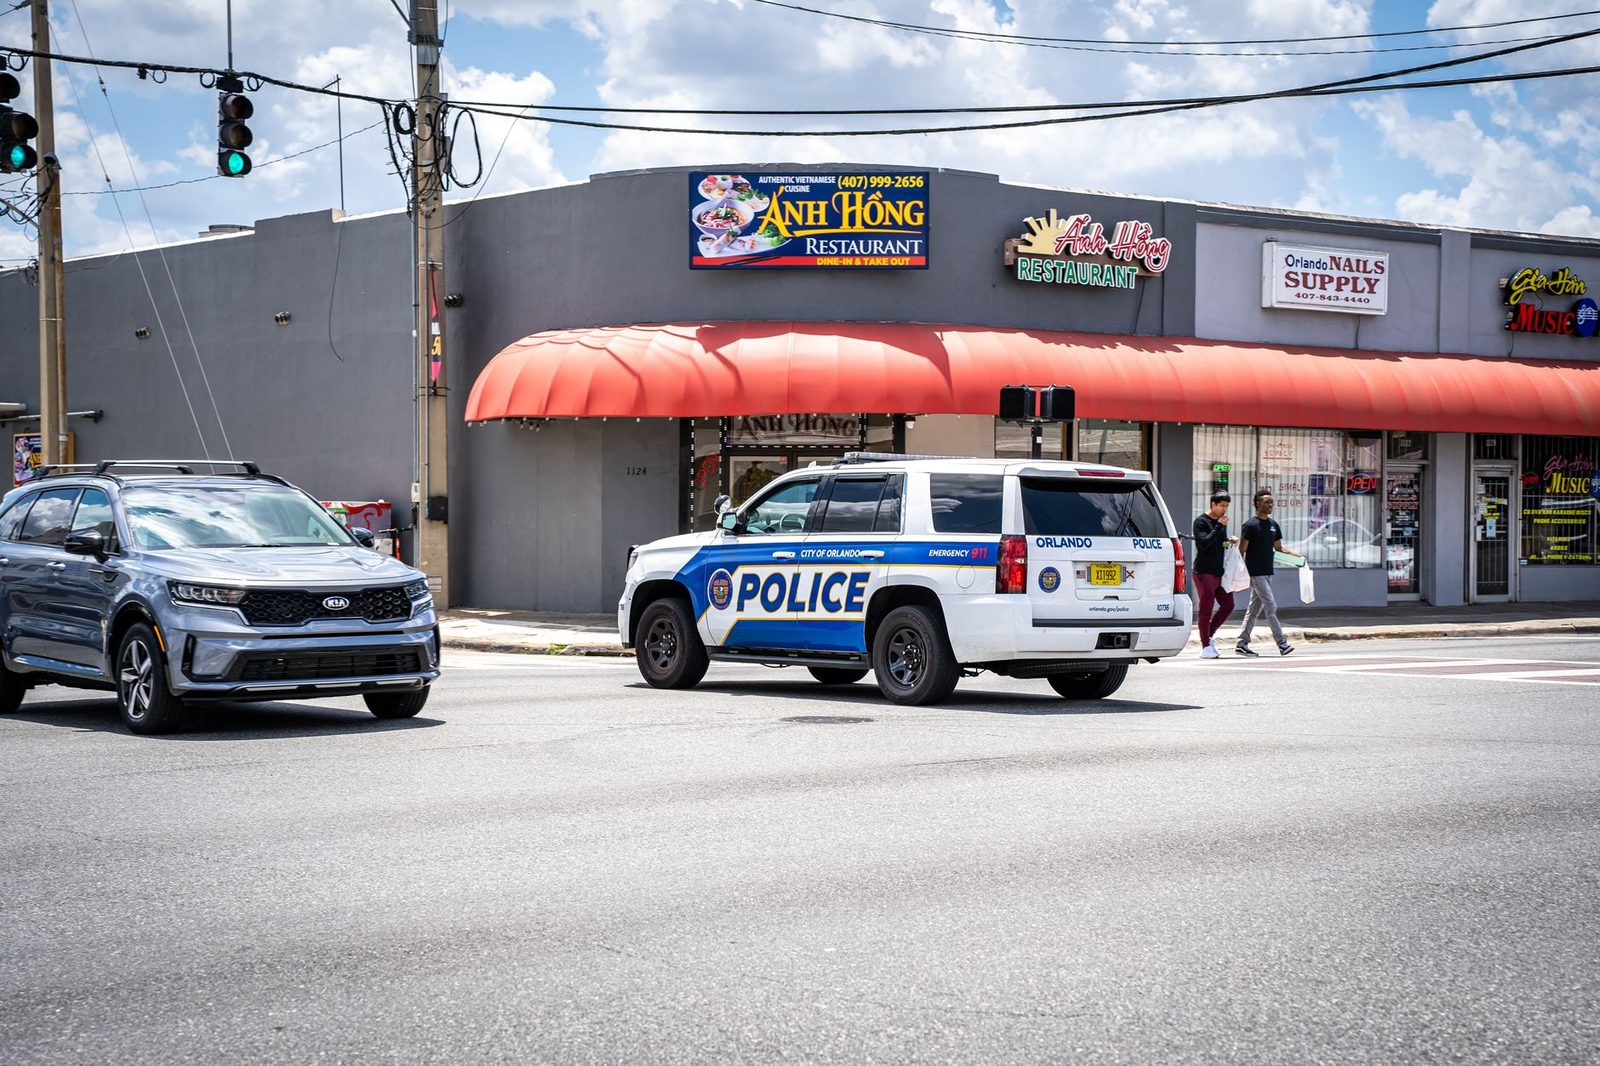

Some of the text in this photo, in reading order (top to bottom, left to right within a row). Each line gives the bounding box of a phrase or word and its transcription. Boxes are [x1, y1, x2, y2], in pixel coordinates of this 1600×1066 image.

[758, 176, 836, 184] AUTHENTIC VIETNAMESE
[837, 175, 924, 190] (407) 999-2656
[784, 185, 810, 193] CUISINE
[805, 238, 923, 255] RESTAURANT
[816, 258, 911, 266] DINE-IN & TAKE OUT
[1285, 254, 1386, 275] Orlando NAILS
[1017, 257, 1139, 290] RESTAURANT
[1284, 271, 1381, 295] SUPPLY
[1294, 292, 1370, 304] 407-843-4440
[1510, 303, 1576, 336] MUSIC
[626, 466, 648, 476] 1124
[1346, 477, 1377, 491] OPEN
[1546, 472, 1591, 494] MUSIC
[1036, 537, 1093, 549] ORLANDO
[1133, 538, 1163, 550] POLICE
[800, 549, 862, 558] CITY OF ORLANDO
[928, 547, 988, 559] EMERGENCY 911
[736, 571, 872, 614] POLICE
[327, 599, 346, 608] KIA
[1088, 605, 1130, 613] orlando.gov/police
[1156, 603, 1170, 612] 10736
